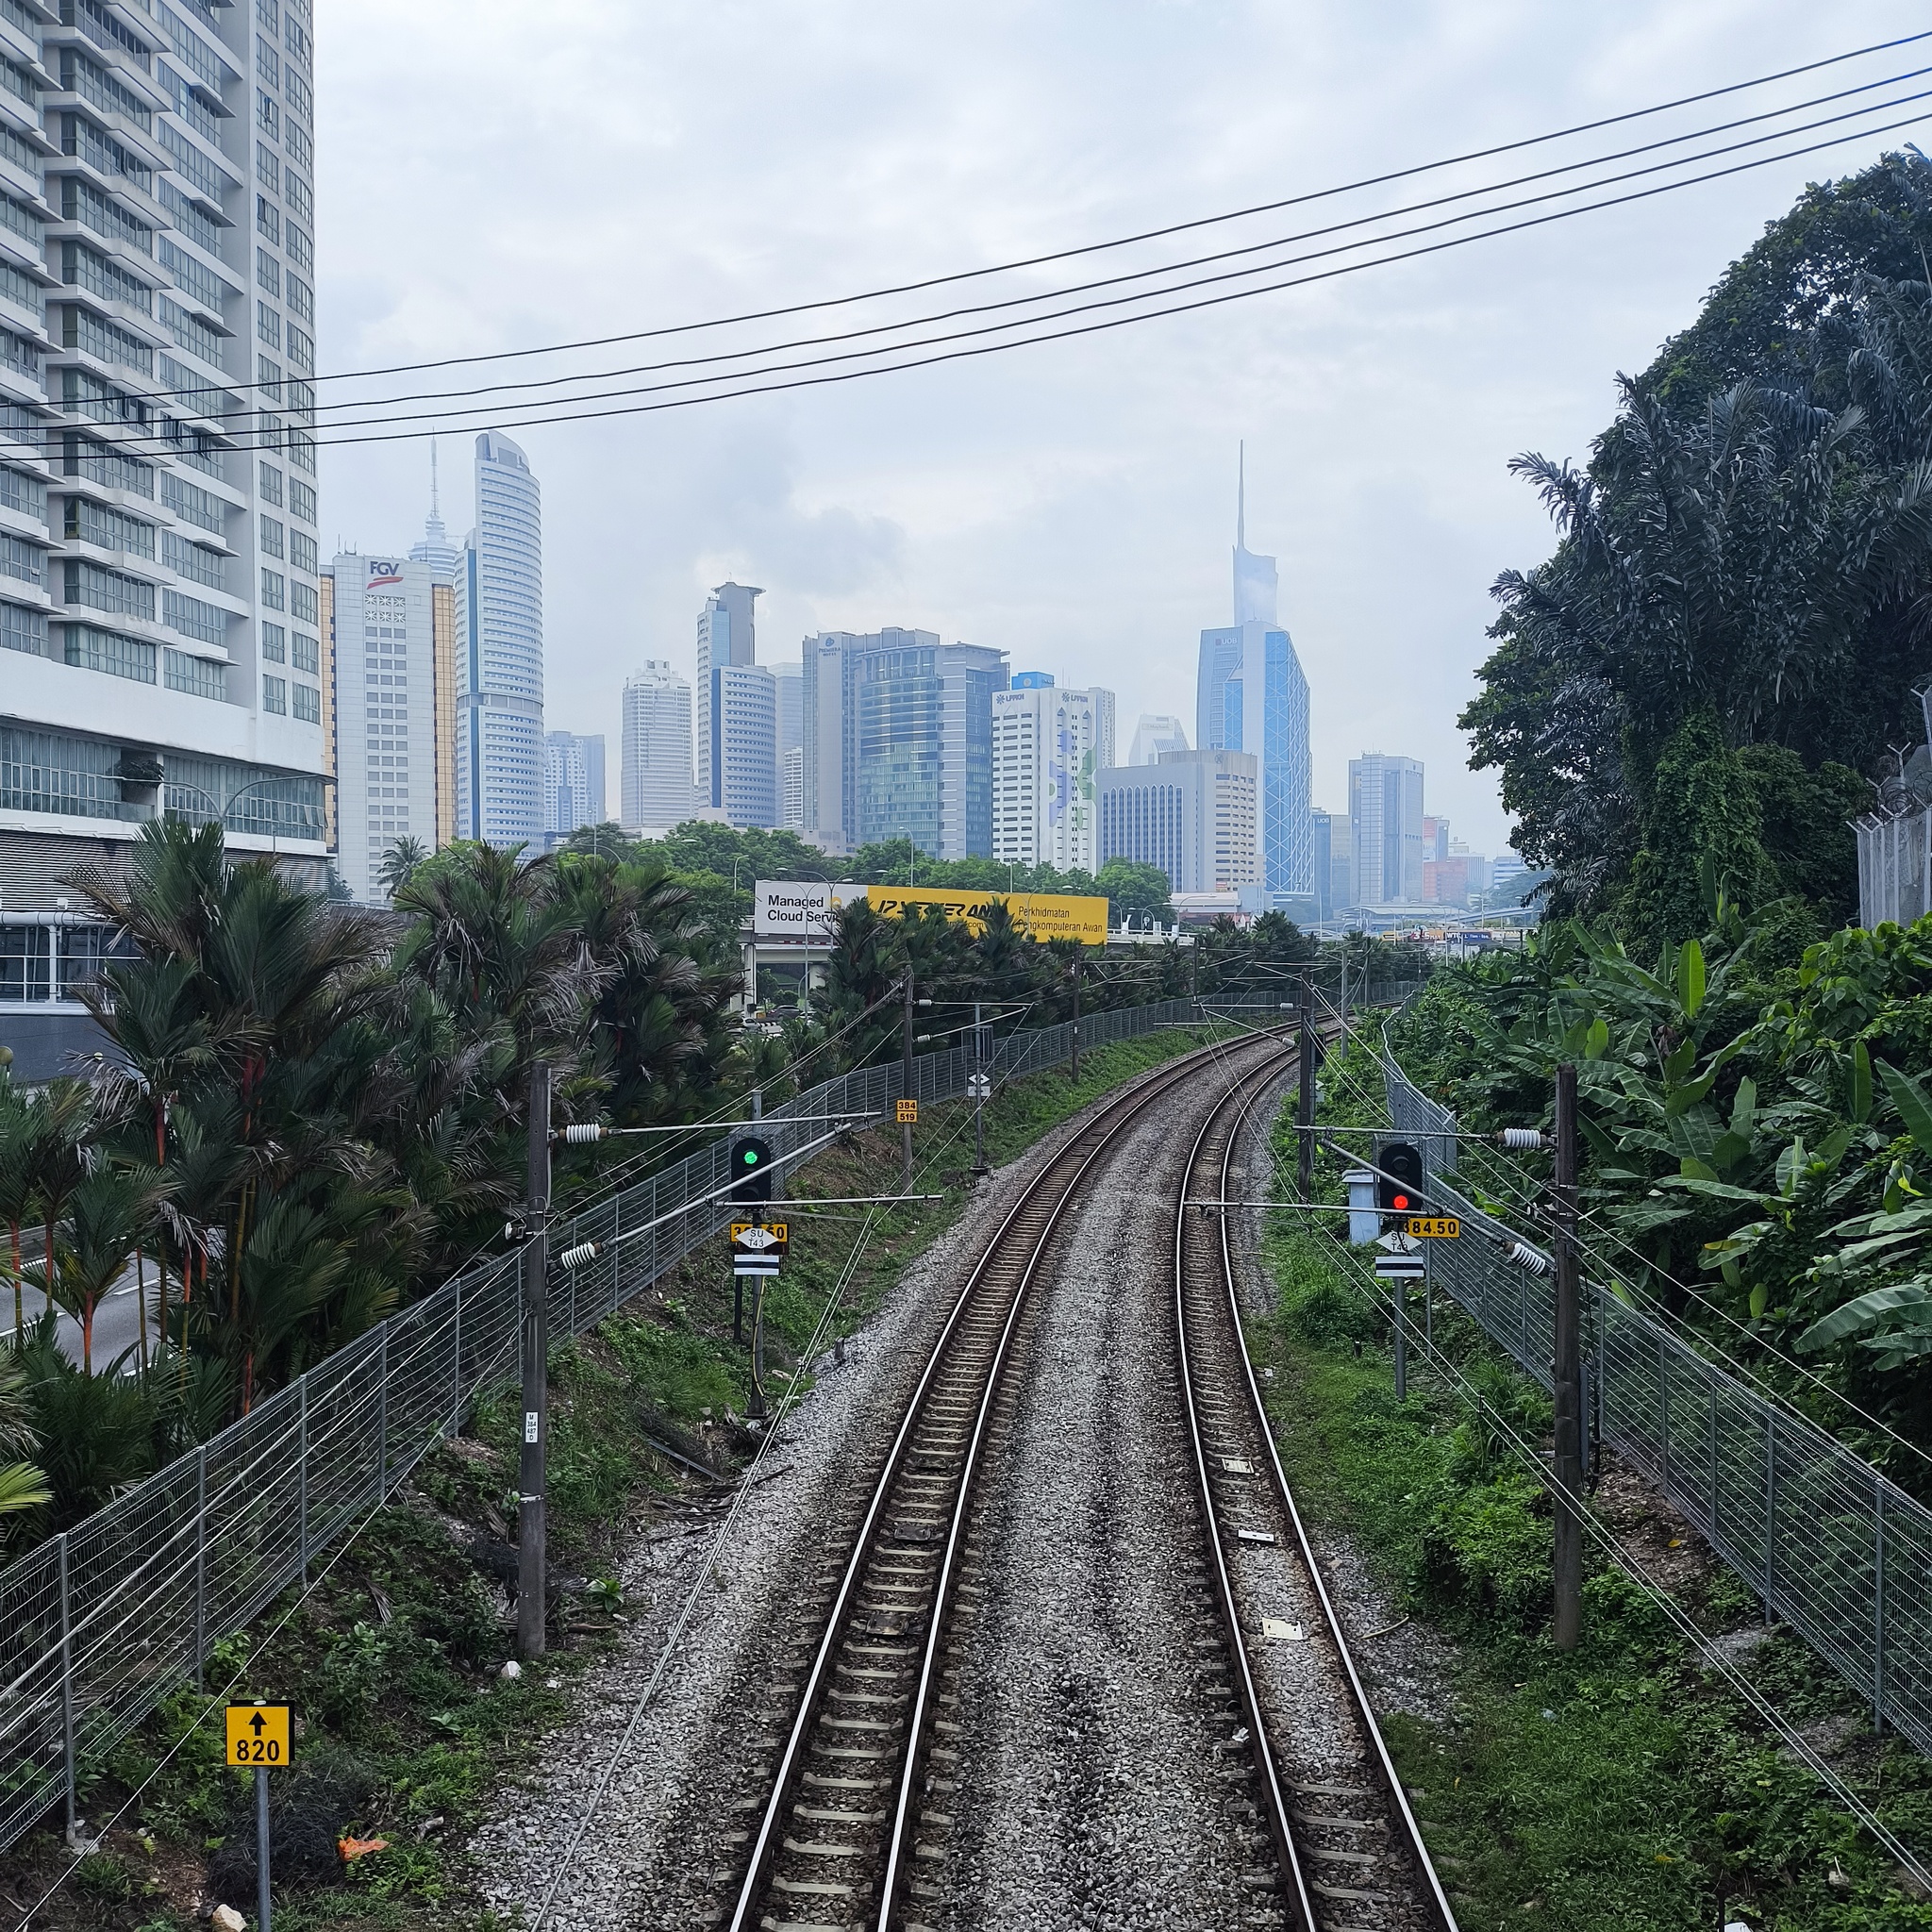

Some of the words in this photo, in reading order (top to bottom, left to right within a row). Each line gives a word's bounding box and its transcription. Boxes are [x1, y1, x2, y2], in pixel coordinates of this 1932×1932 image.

[370, 561, 399, 575] FGV
[768, 894, 824, 909] Managed
[768, 909, 802, 922] Cloud
[1018, 906, 1070, 918] Perkhidmatan
[1082, 923, 1103, 932] Awan
[898, 1101, 916, 1109] 384
[750, 1229, 764, 1238] SU
[748, 1239, 764, 1248] T43
[236, 1739, 280, 1762] 820
